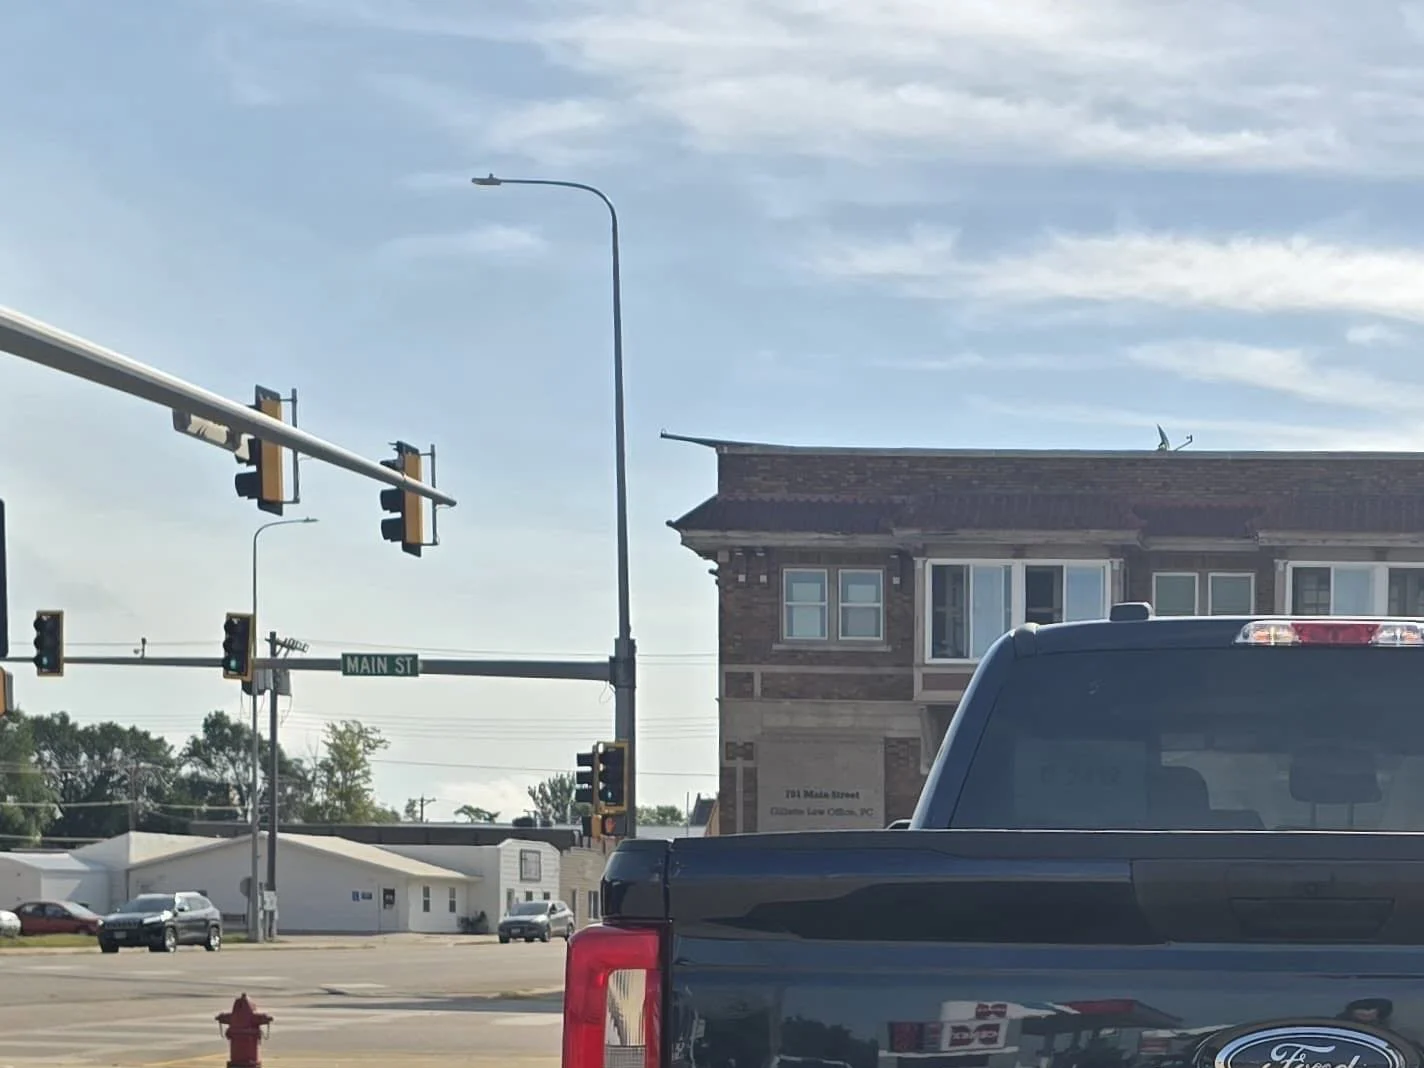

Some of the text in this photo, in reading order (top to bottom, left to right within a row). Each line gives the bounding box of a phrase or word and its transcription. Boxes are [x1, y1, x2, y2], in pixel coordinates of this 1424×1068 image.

[346, 655, 413, 675] MAIN ST
[803, 789, 830, 800] Main
[831, 790, 860, 800] Street
[806, 807, 826, 816] Law
